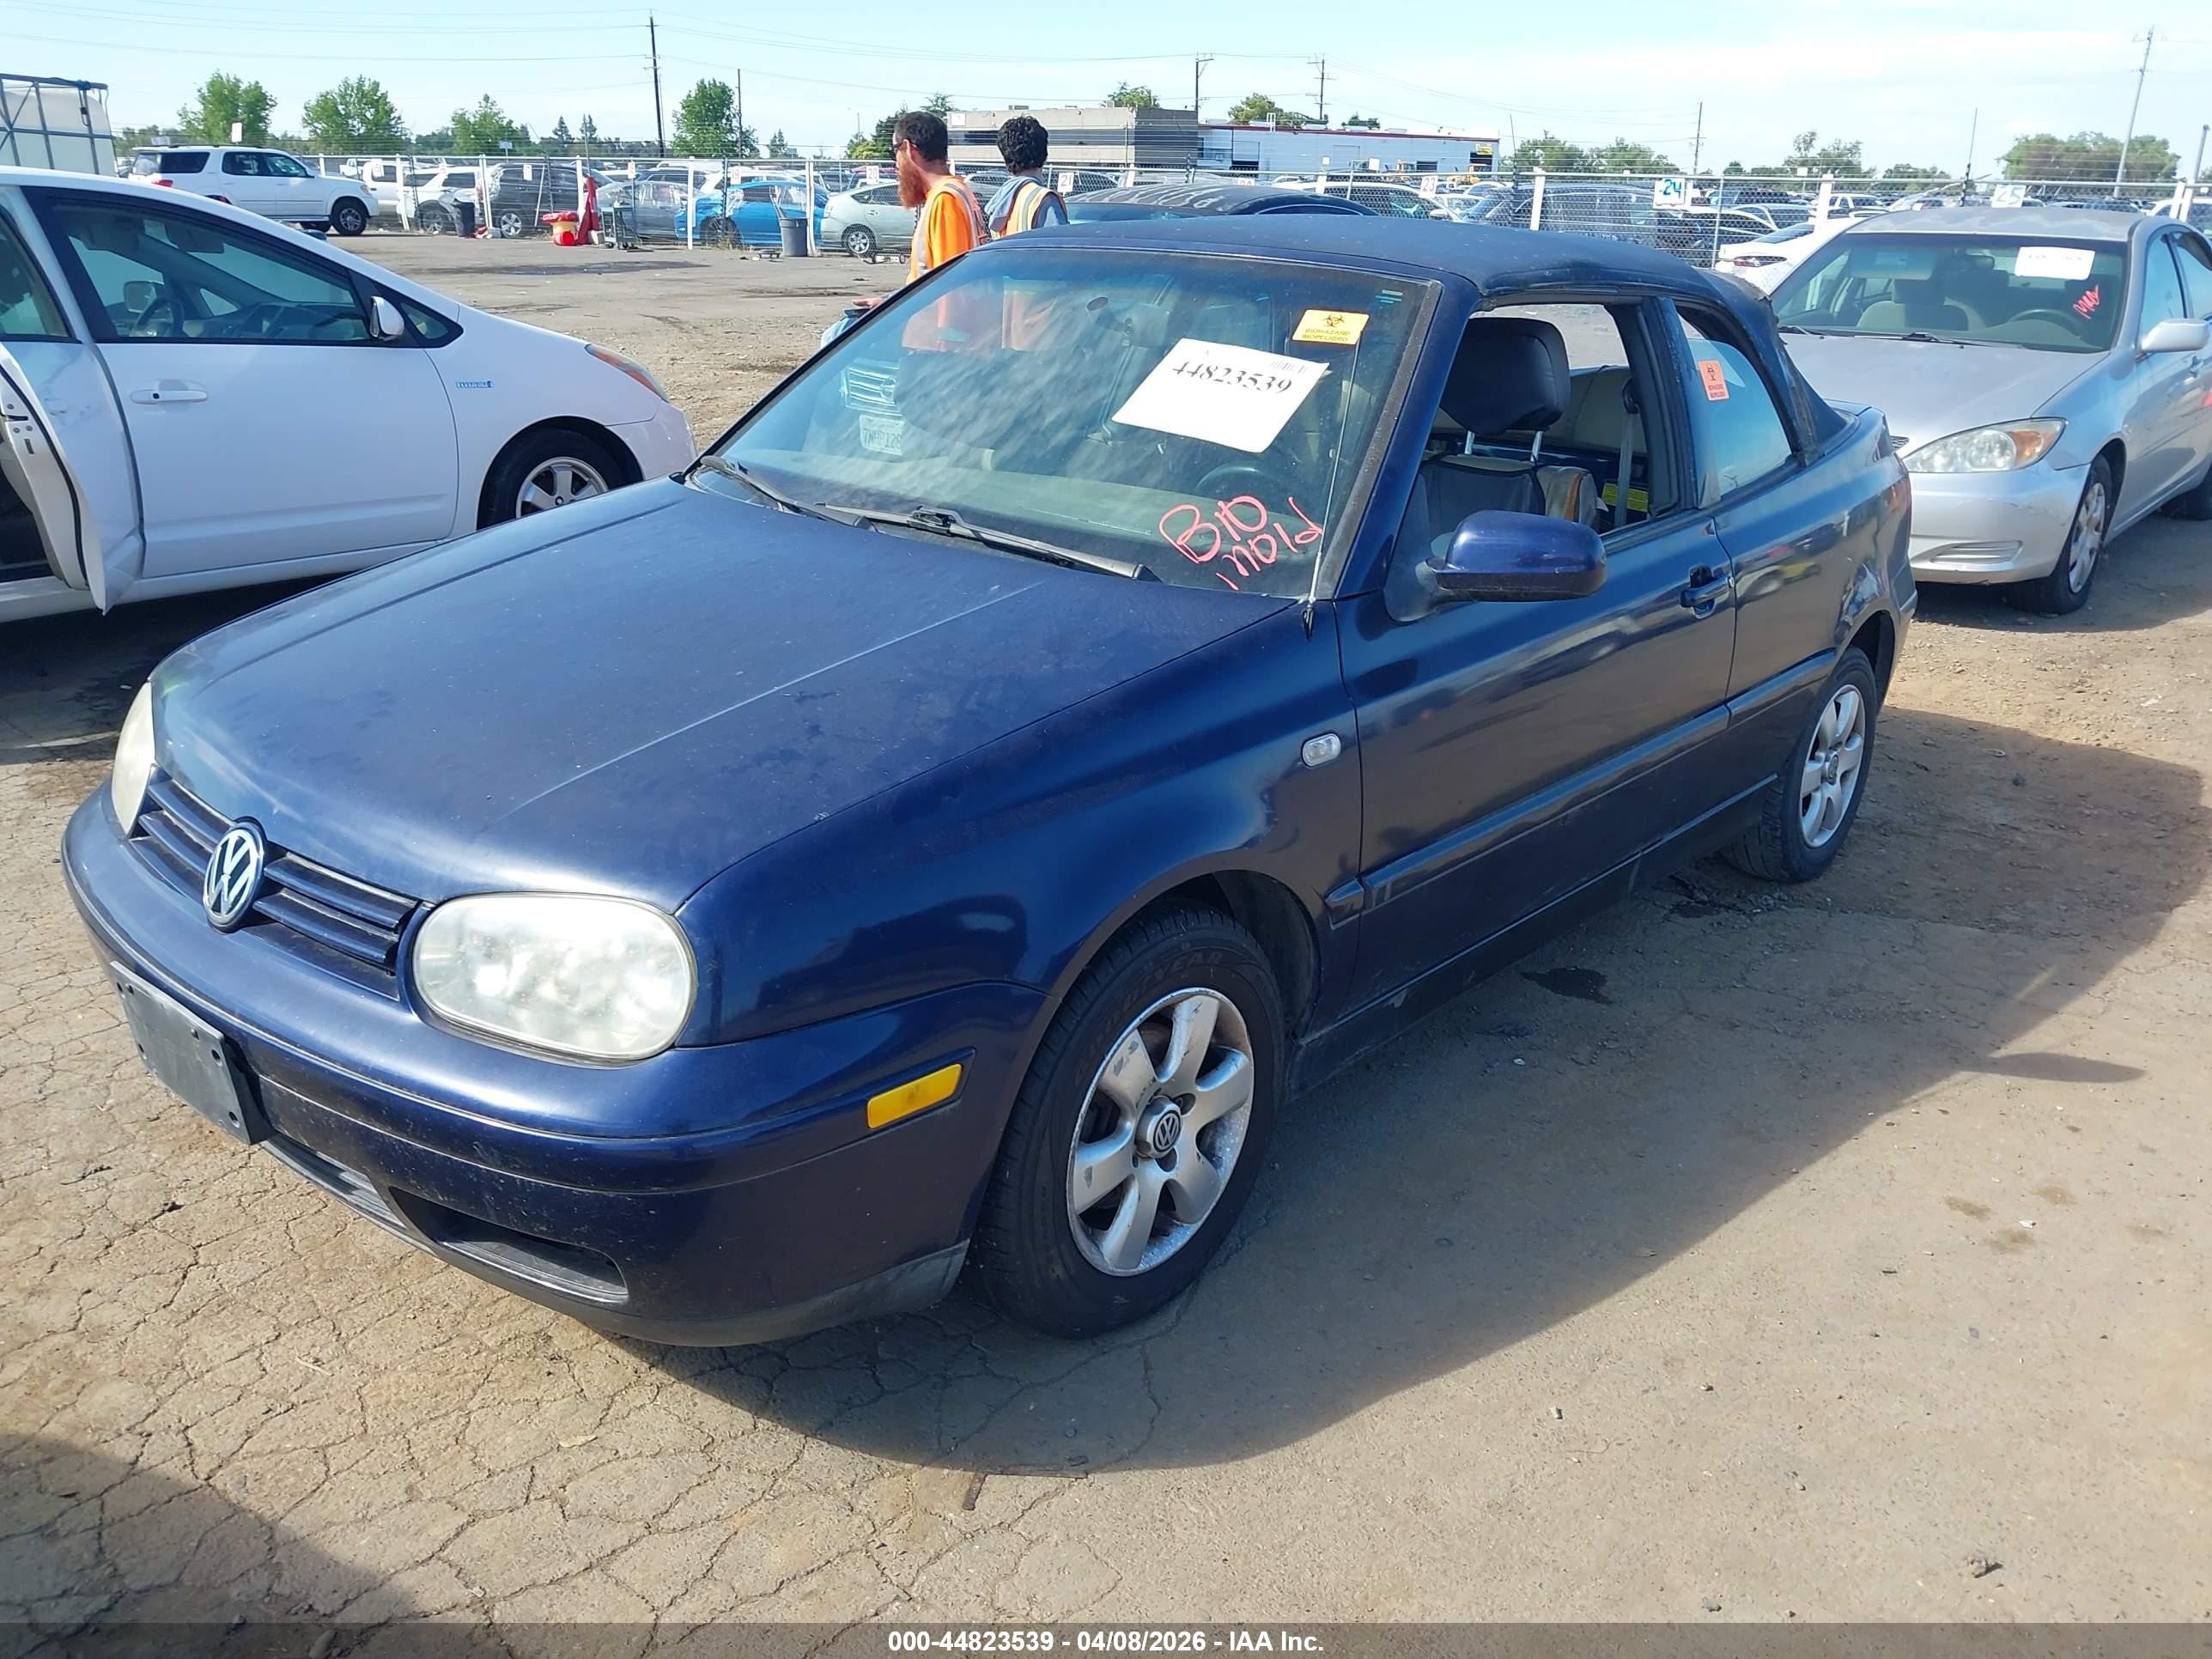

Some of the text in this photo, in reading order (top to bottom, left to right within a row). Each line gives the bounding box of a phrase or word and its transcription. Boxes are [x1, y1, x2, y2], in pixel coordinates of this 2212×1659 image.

[1060, 174, 1073, 186] 21
[1662, 179, 1682, 199] 24
[1995, 185, 2024, 205] 25
[1172, 362, 1291, 393] 44823539
[1159, 495, 1267, 563] BIO
